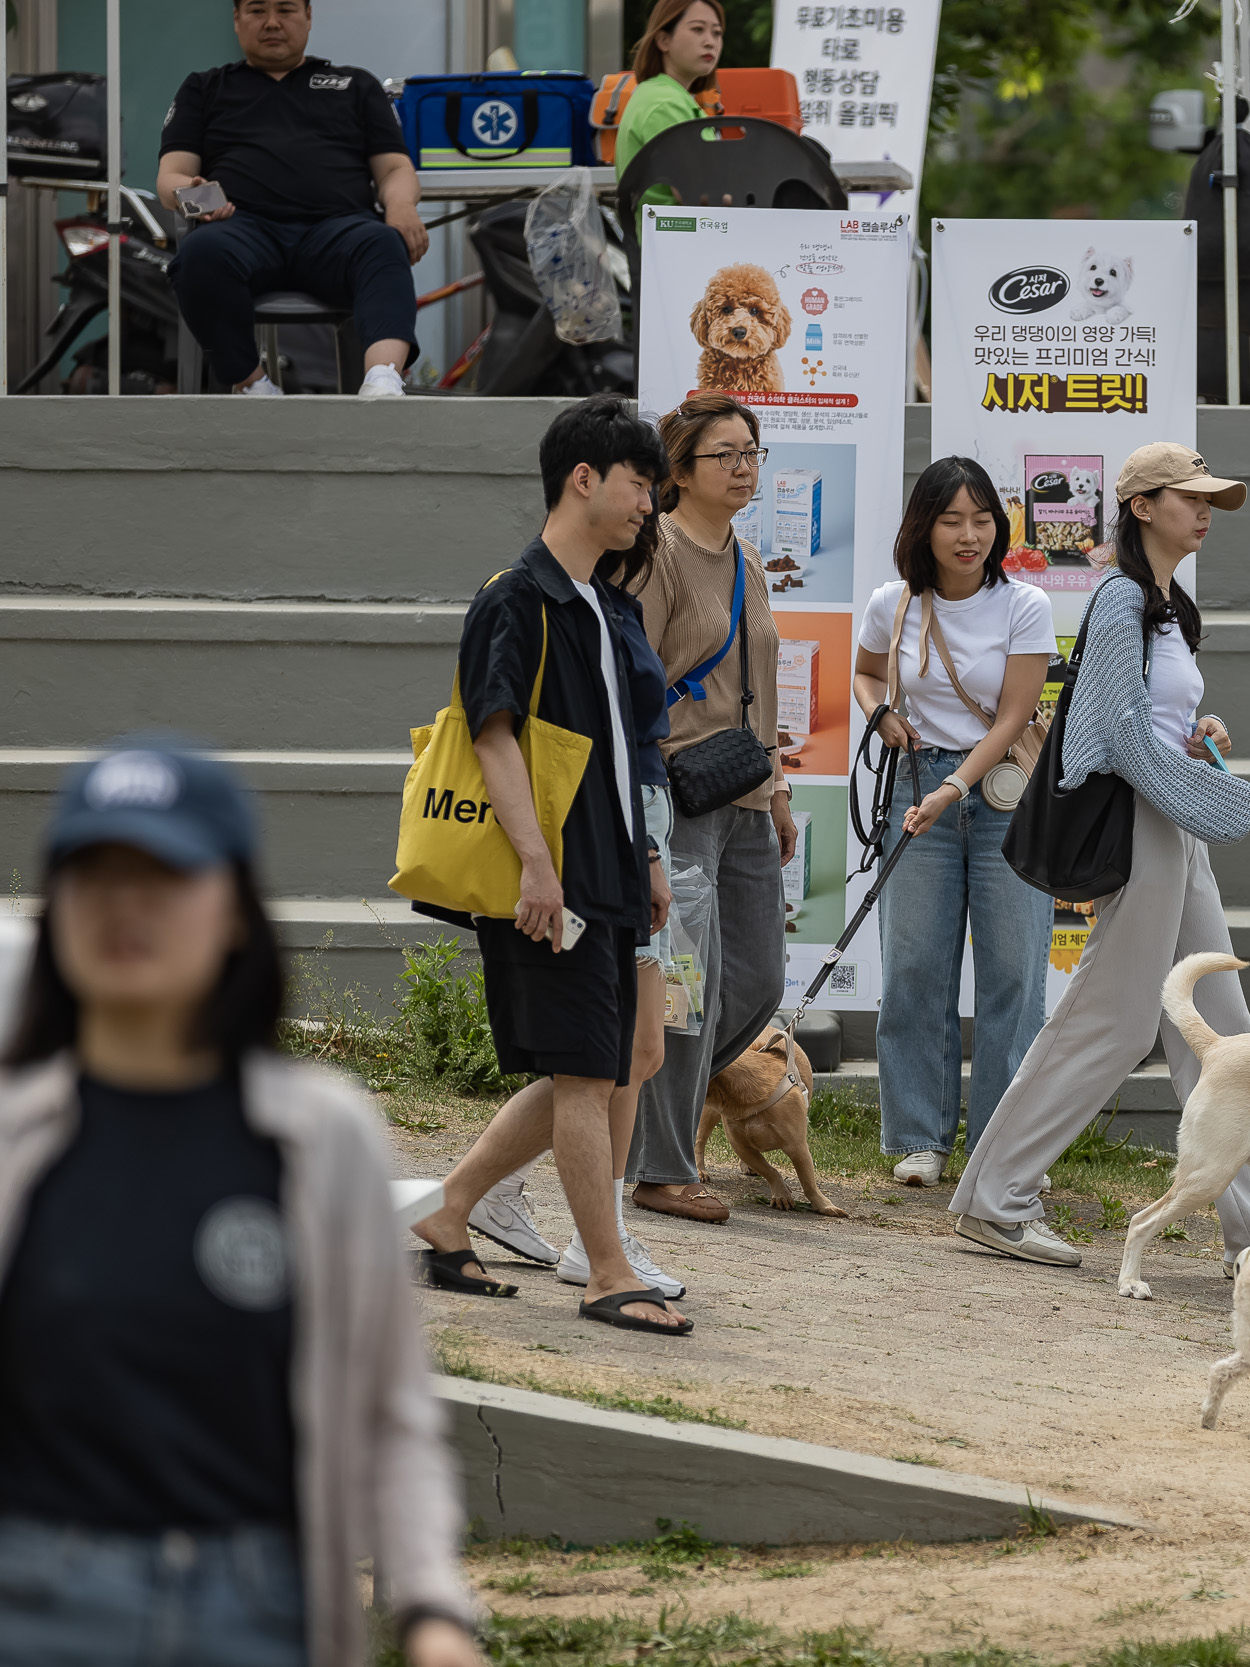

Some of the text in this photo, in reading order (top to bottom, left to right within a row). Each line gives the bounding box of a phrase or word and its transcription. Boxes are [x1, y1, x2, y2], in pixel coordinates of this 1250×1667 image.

[796, 6, 907, 34] 무료기초미용
[805, 69, 880, 96] 행동상담
[660, 220, 674, 228] KU
[840, 219, 859, 229] LAB
[861, 221, 898, 233] 랩솔루션
[1028, 273, 1047, 283] 시저
[998, 274, 1063, 304] Cesar
[804, 296, 825, 304] HUMAN
[805, 303, 824, 311] GRADE
[973, 325, 1157, 343] 우리 댕댕이의 영양 가득!
[806, 337, 822, 345] Milk
[974, 347, 1156, 367] 맛있는 프리미엄 간식!
[746, 393, 766, 403] 건국대
[1065, 373, 1146, 412] 트릿!
[1034, 475, 1065, 489] Cesar
[999, 486, 1021, 494] 바나나!
[1023, 574, 1065, 587] 바나나와
[1066, 574, 1088, 587] 우유
